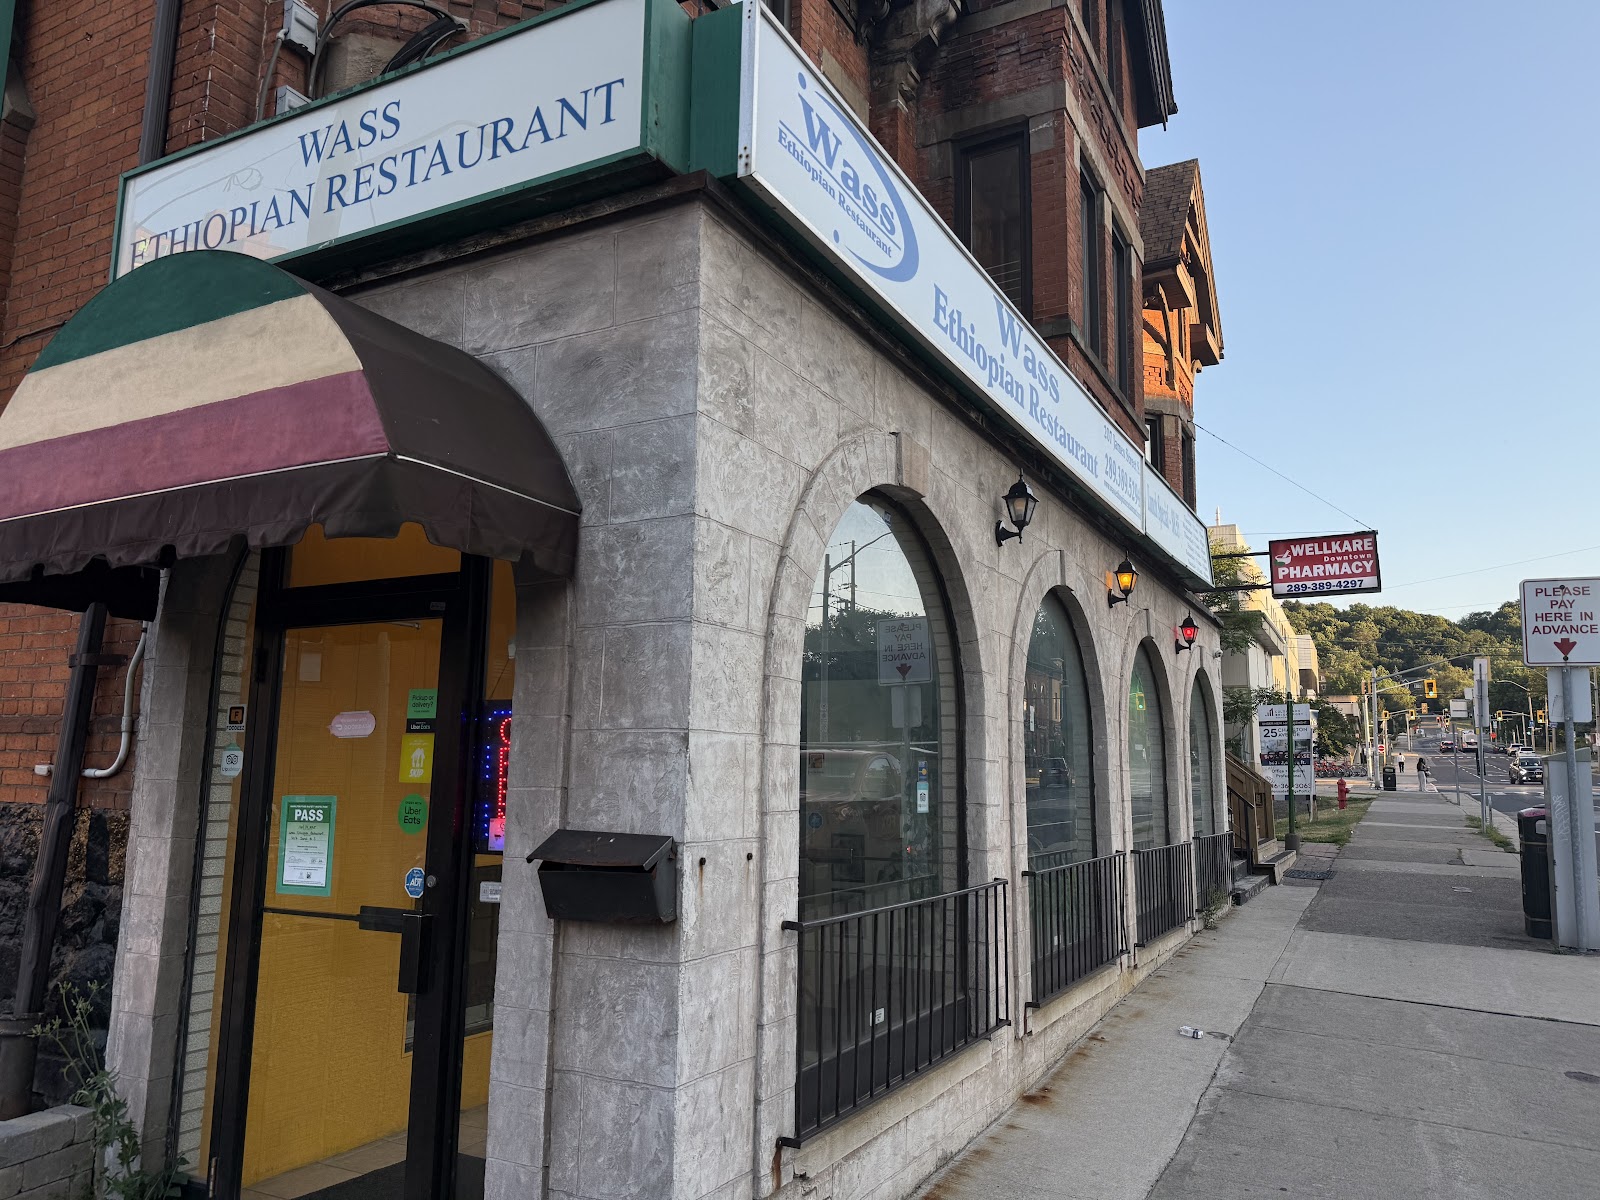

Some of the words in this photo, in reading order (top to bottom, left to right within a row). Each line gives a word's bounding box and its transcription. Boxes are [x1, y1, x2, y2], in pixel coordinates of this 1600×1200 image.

[299, 99, 401, 167] WASS
[798, 92, 896, 237] Wass
[130, 182, 315, 270] ETHIOPIAN
[323, 78, 625, 213] RESTAURANT
[778, 126, 836, 200] Ethiopian
[838, 191, 892, 258] Restaurant
[993, 294, 1060, 404] Wass
[933, 283, 1025, 409] Ethiopian
[1028, 383, 1099, 478] Restaurant
[1290, 538, 1374, 556] WELLKARE
[1324, 553, 1372, 562] Downtown
[1278, 560, 1374, 579] PHARMACY
[1286, 580, 1364, 593] 289-389-4297
[1535, 586, 1590, 597] PLEASE
[1550, 599, 1575, 609] PAY
[1535, 612, 1572, 622] HERE
[1580, 611, 1593, 621] IN
[1532, 624, 1599, 635] ADVANCE
[411, 701, 434, 709] delivery?
[1263, 728, 1277, 738] 25
[294, 809, 324, 822] PASS
[404, 806, 421, 815] Uber
[403, 816, 421, 825] Eats
[410, 877, 422, 887] ADT
